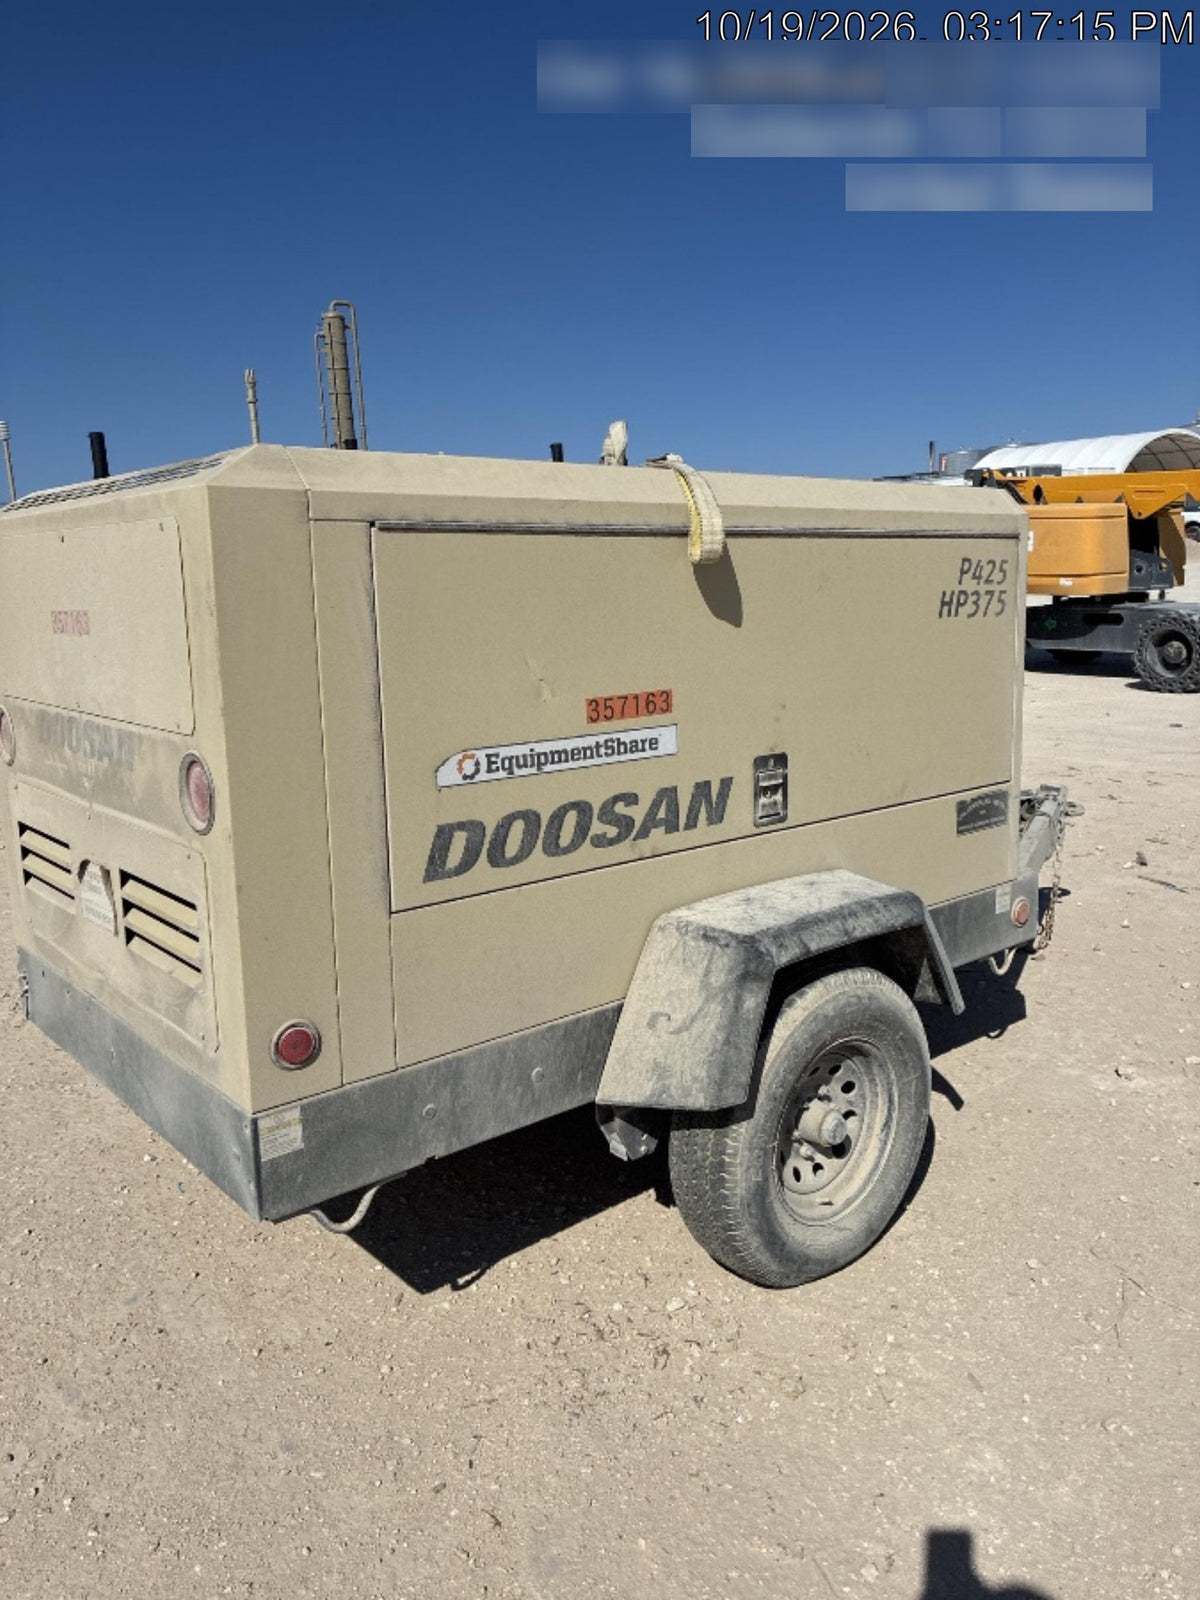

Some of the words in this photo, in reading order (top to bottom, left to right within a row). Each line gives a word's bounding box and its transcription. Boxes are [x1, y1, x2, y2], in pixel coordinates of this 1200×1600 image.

[957, 557, 1009, 586] P425
[938, 589, 1008, 619] HP375
[588, 690, 672, 724] 357163
[485, 733, 660, 774] EquipmentShare
[423, 776, 733, 883] DOOSAN
